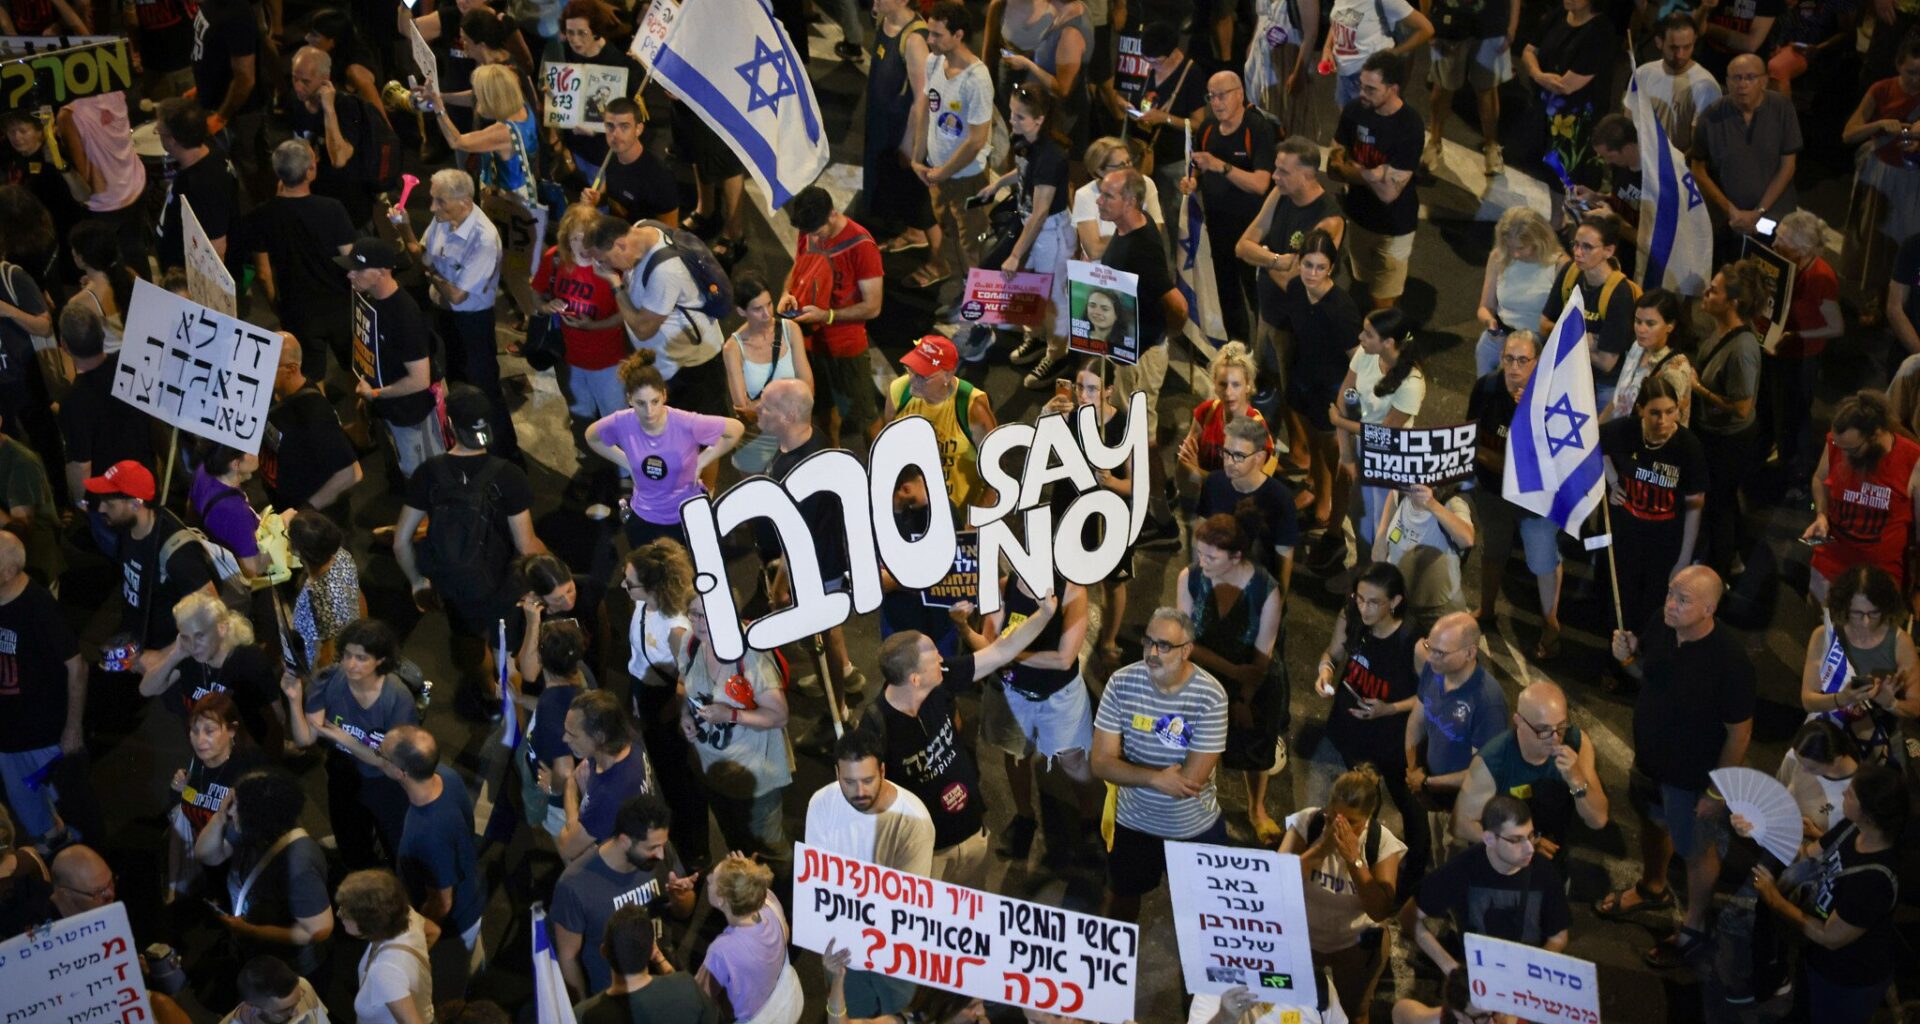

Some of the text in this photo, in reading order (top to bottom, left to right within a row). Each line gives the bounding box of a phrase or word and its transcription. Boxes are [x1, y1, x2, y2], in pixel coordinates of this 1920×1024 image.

[551, 94, 573, 110] 673
[176, 309, 218, 349] לא
[119, 363, 257, 440] שאני רוצה
[968, 391, 1150, 548] SAY
[1363, 463, 1474, 484] OPPOSE THE WAR
[1364, 446, 1476, 474] למלחמה
[977, 488, 1131, 616] NO
[1196, 852, 1270, 872] תשעה
[798, 849, 933, 909] ההסתדרות
[1207, 876, 1258, 894] באב
[1217, 895, 1264, 913] עבר
[1000, 901, 1065, 943] המשק
[1199, 913, 1283, 935] החורבן
[19, 920, 107, 959] החטופים
[814, 887, 1128, 990] איך אתם משאירים אותם
[1077, 918, 1136, 957] ראשי
[1213, 935, 1275, 953] שלכם
[861, 928, 1084, 1013] ככה למות?
[1210, 953, 1275, 972] נשאר
[1474, 950, 1484, 967] 1
[1472, 979, 1487, 997] 0
[1527, 963, 1582, 990] סדום
[1512, 989, 1598, 1024] ממשלה
